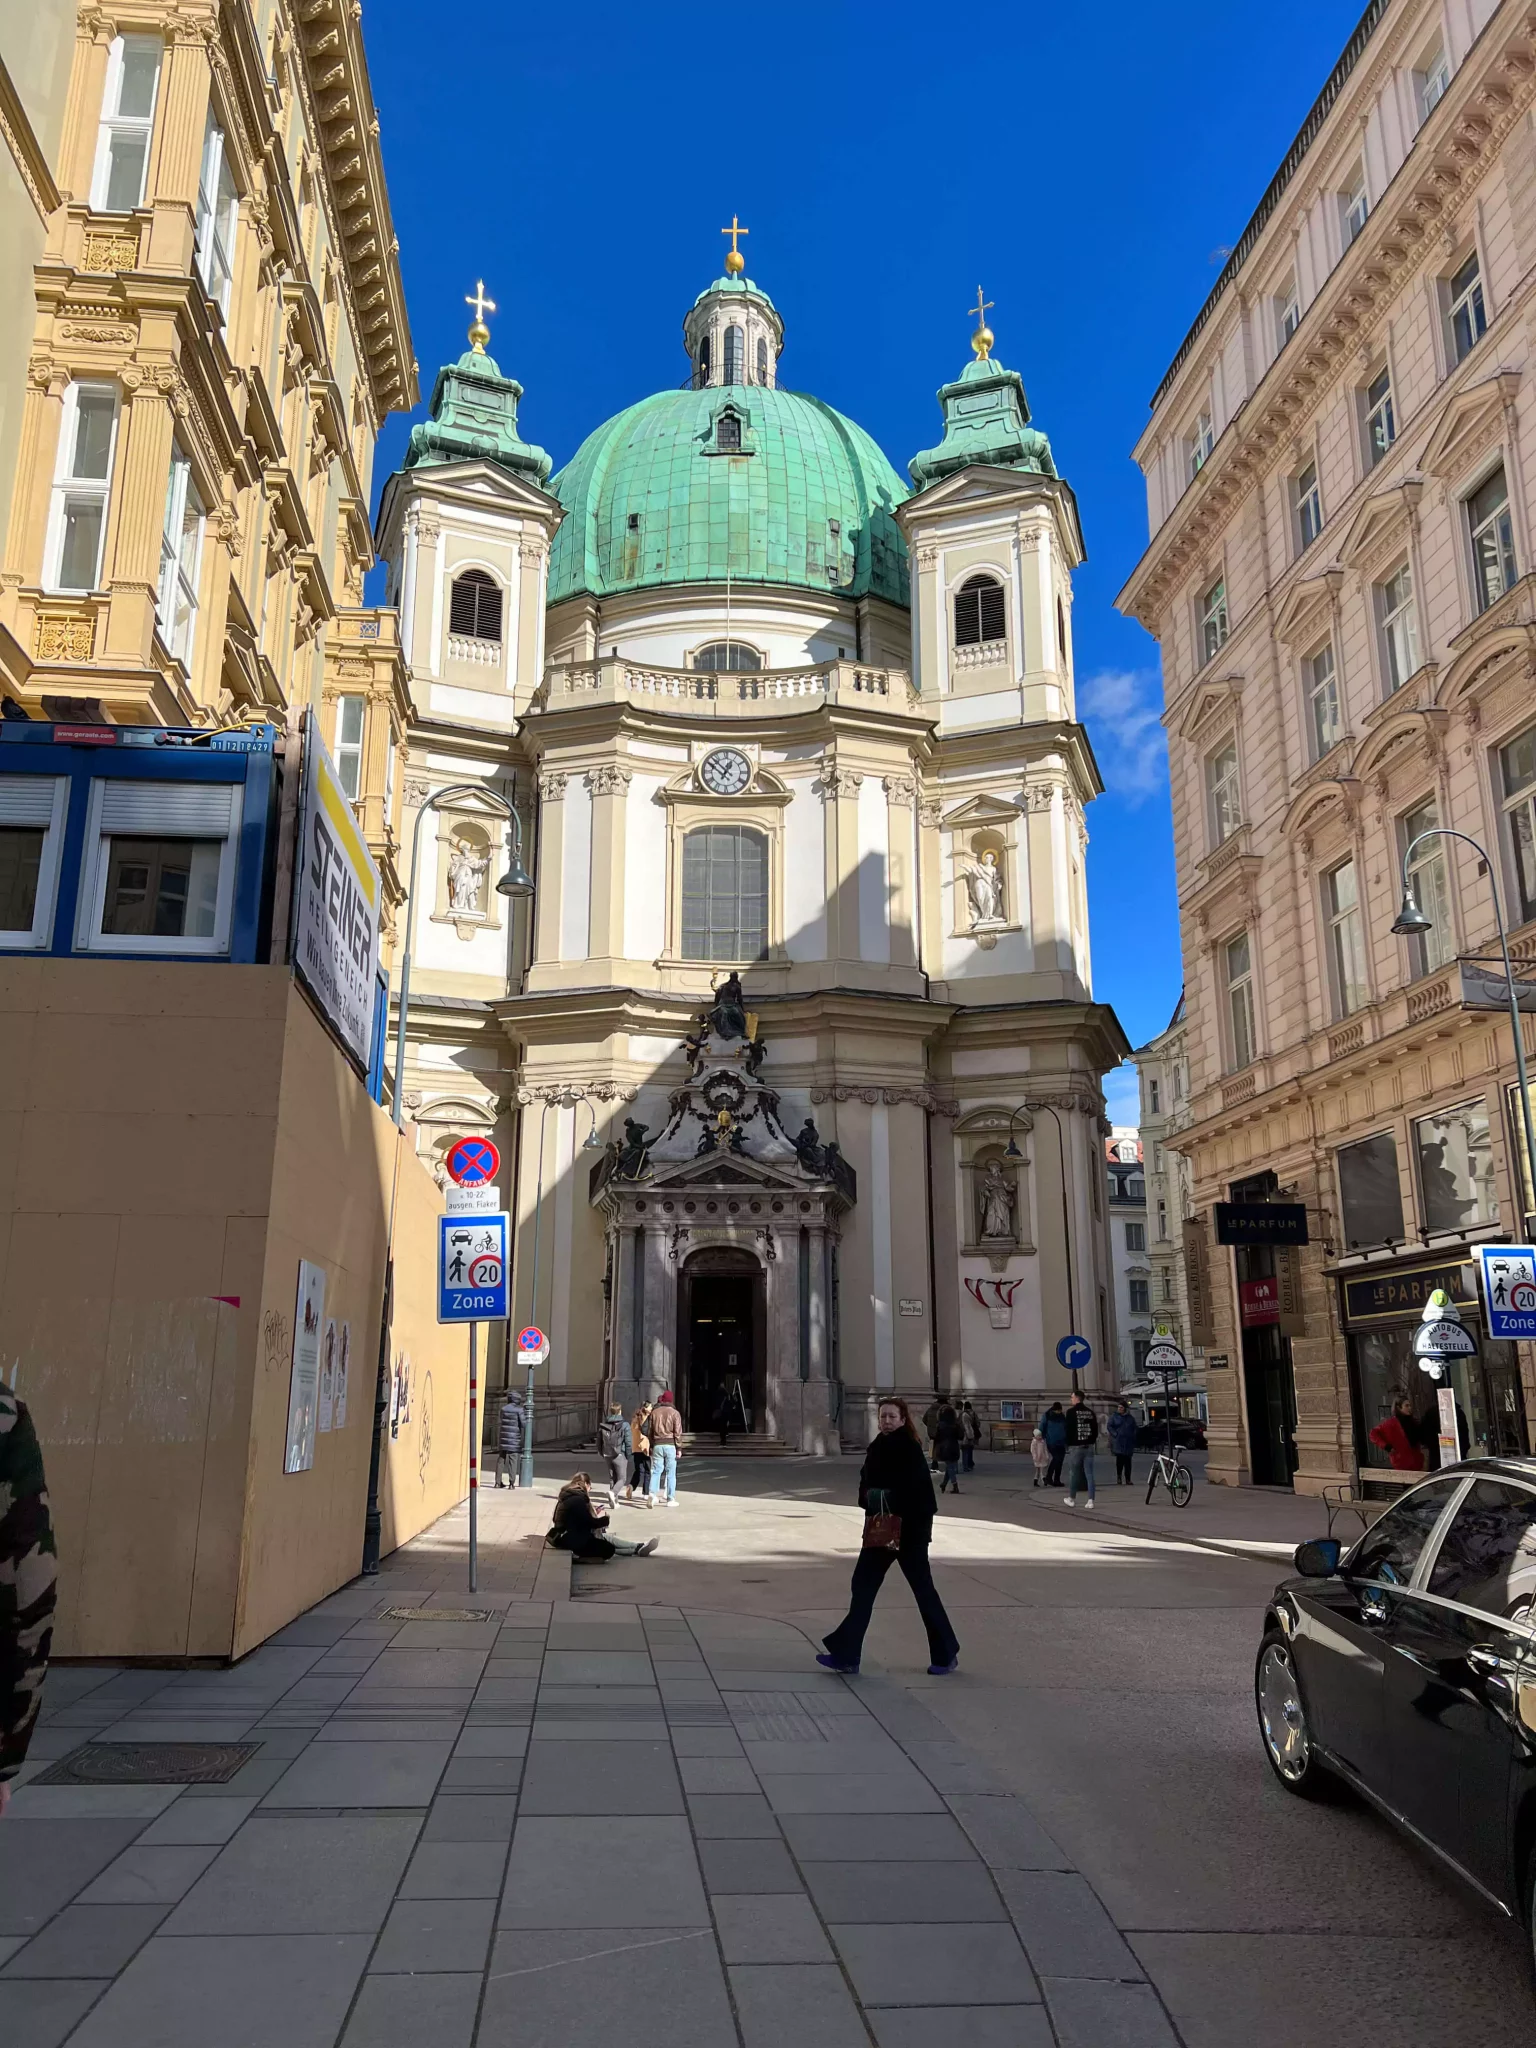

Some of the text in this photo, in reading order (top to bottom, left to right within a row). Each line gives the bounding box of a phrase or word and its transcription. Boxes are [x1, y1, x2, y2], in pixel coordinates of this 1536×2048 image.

[227, 742, 237, 751] 12
[311, 811, 371, 982] STEINER
[308, 889, 368, 1012] HEILIGENEICH
[458, 1178, 488, 1188] ANFANG
[476, 1200, 498, 1209] Fiaker
[1240, 1219, 1297, 1229] PARFUM
[478, 1264, 498, 1283] 20
[452, 1293, 495, 1310] Zone
[1518, 1291, 1535, 1307] 20
[1500, 1315, 1536, 1329] Zone
[1427, 1323, 1462, 1337] AUTOBUS
[1152, 1347, 1177, 1357] AUTOBUS
[1422, 1342, 1469, 1351] HALTESTELLE
